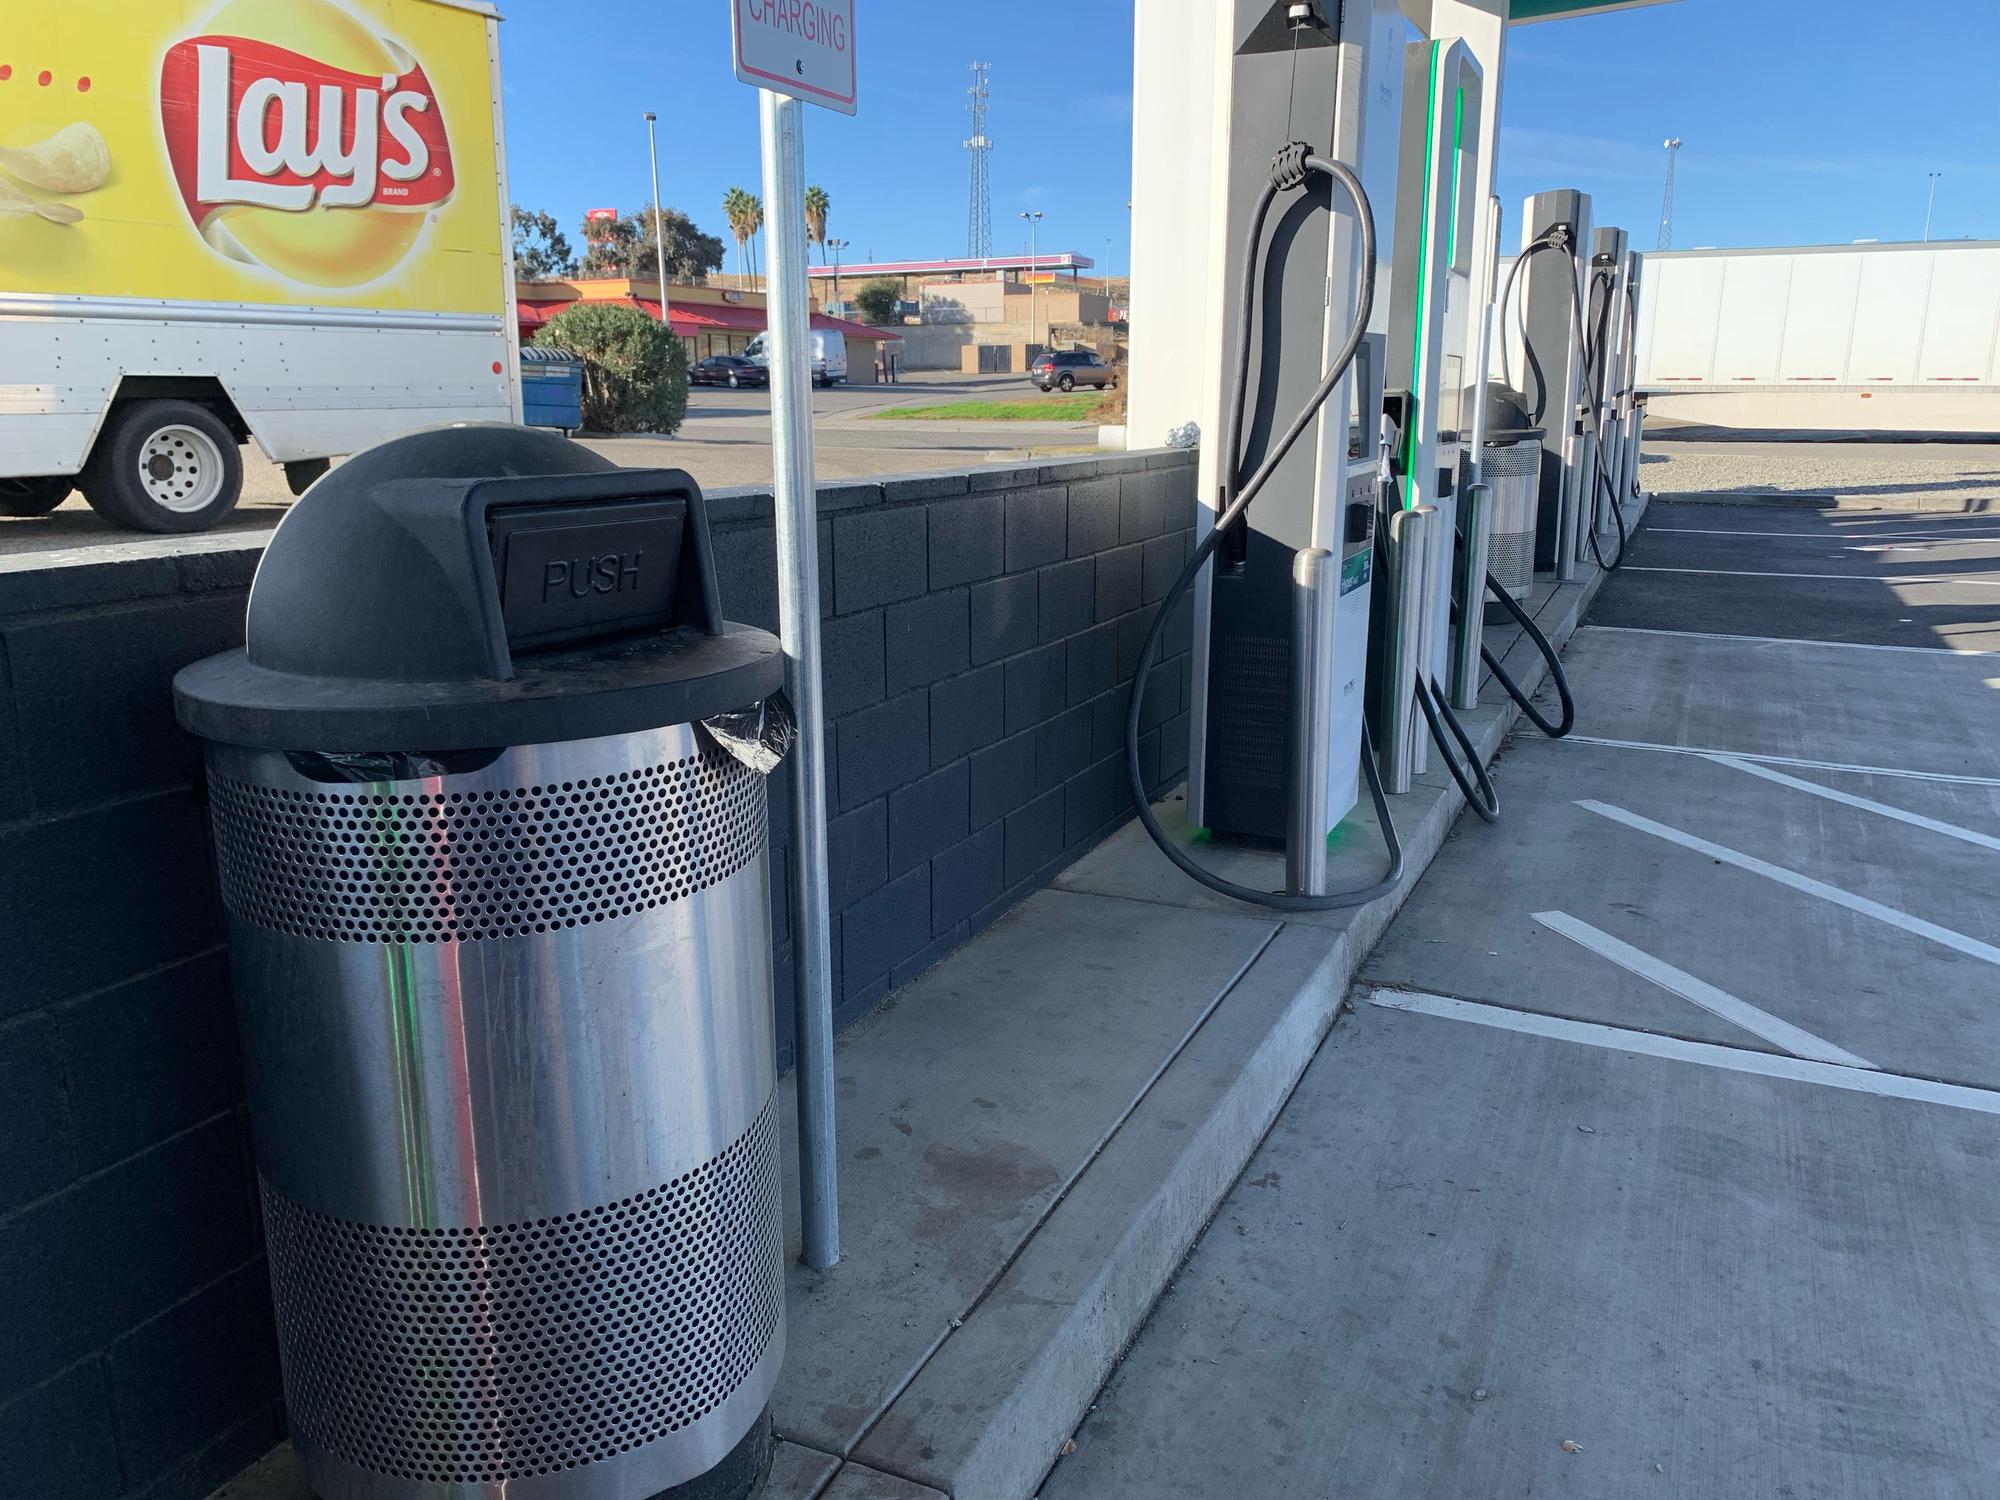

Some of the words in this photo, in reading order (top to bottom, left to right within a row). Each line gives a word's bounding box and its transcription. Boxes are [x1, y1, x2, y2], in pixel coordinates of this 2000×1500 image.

[749, 0, 845, 52] CHARGING
[197, 44, 429, 210] Lay's
[382, 187, 409, 197] BRAND
[542, 549, 644, 604] PUSH
